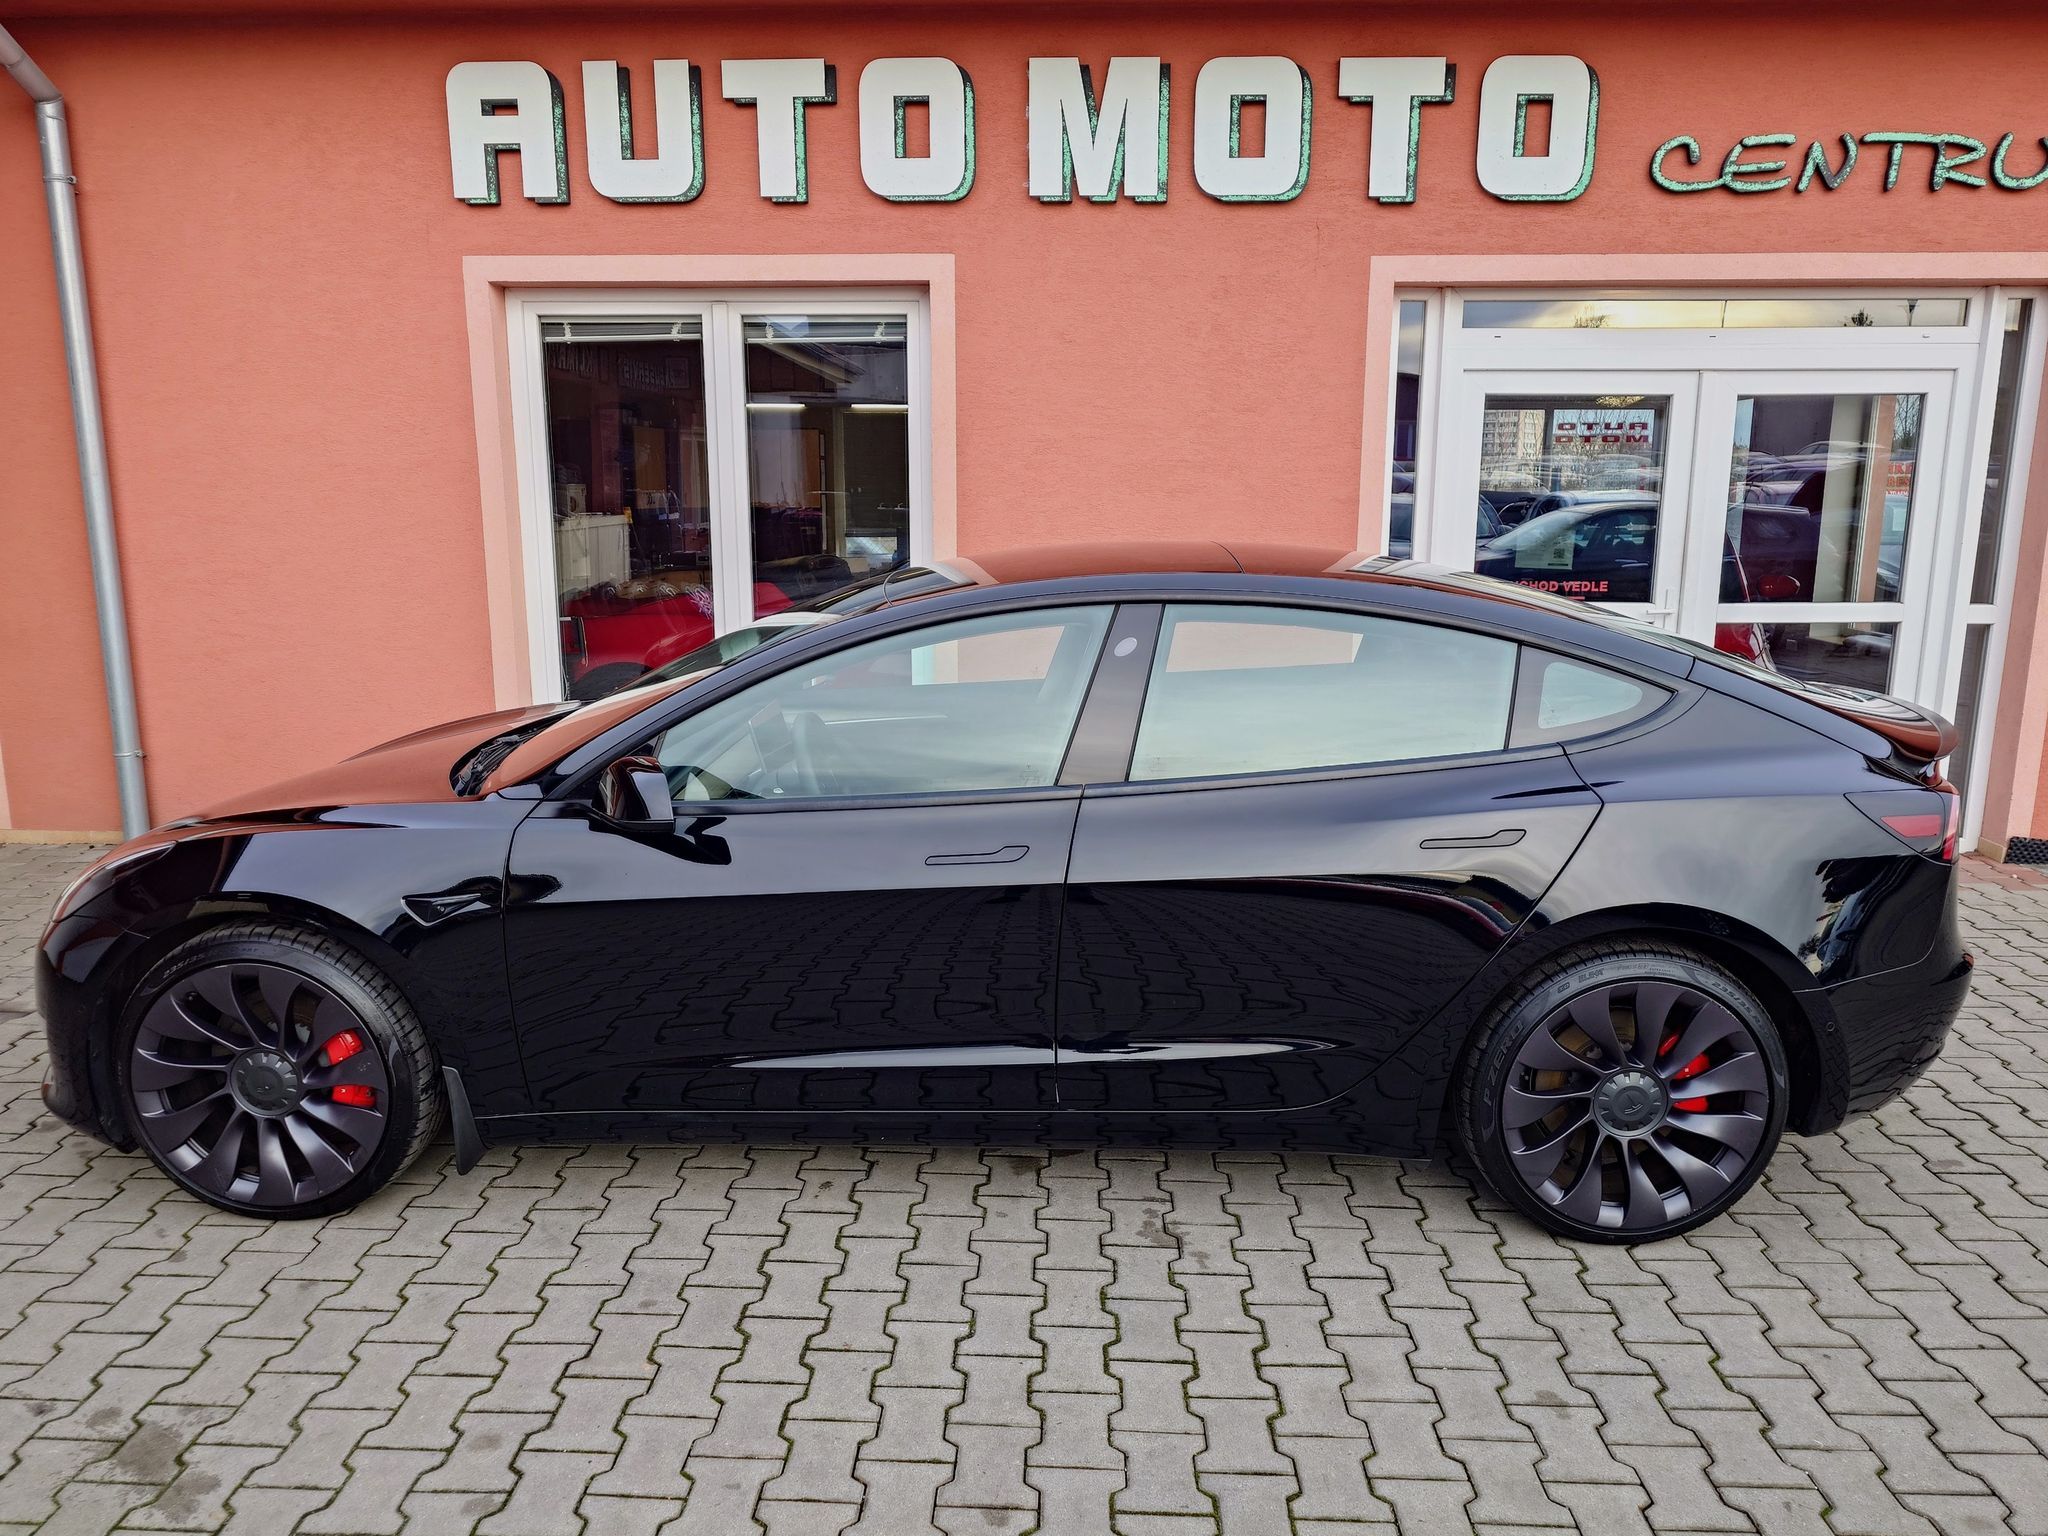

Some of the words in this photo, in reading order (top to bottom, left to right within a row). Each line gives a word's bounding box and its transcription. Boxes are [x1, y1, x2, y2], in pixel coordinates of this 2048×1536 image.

[446, 56, 976, 205] AUTO
[1027, 55, 1600, 204] MOTO
[1650, 131, 2048, 193] CENTRU
[1562, 580, 1609, 592] VEDLE
